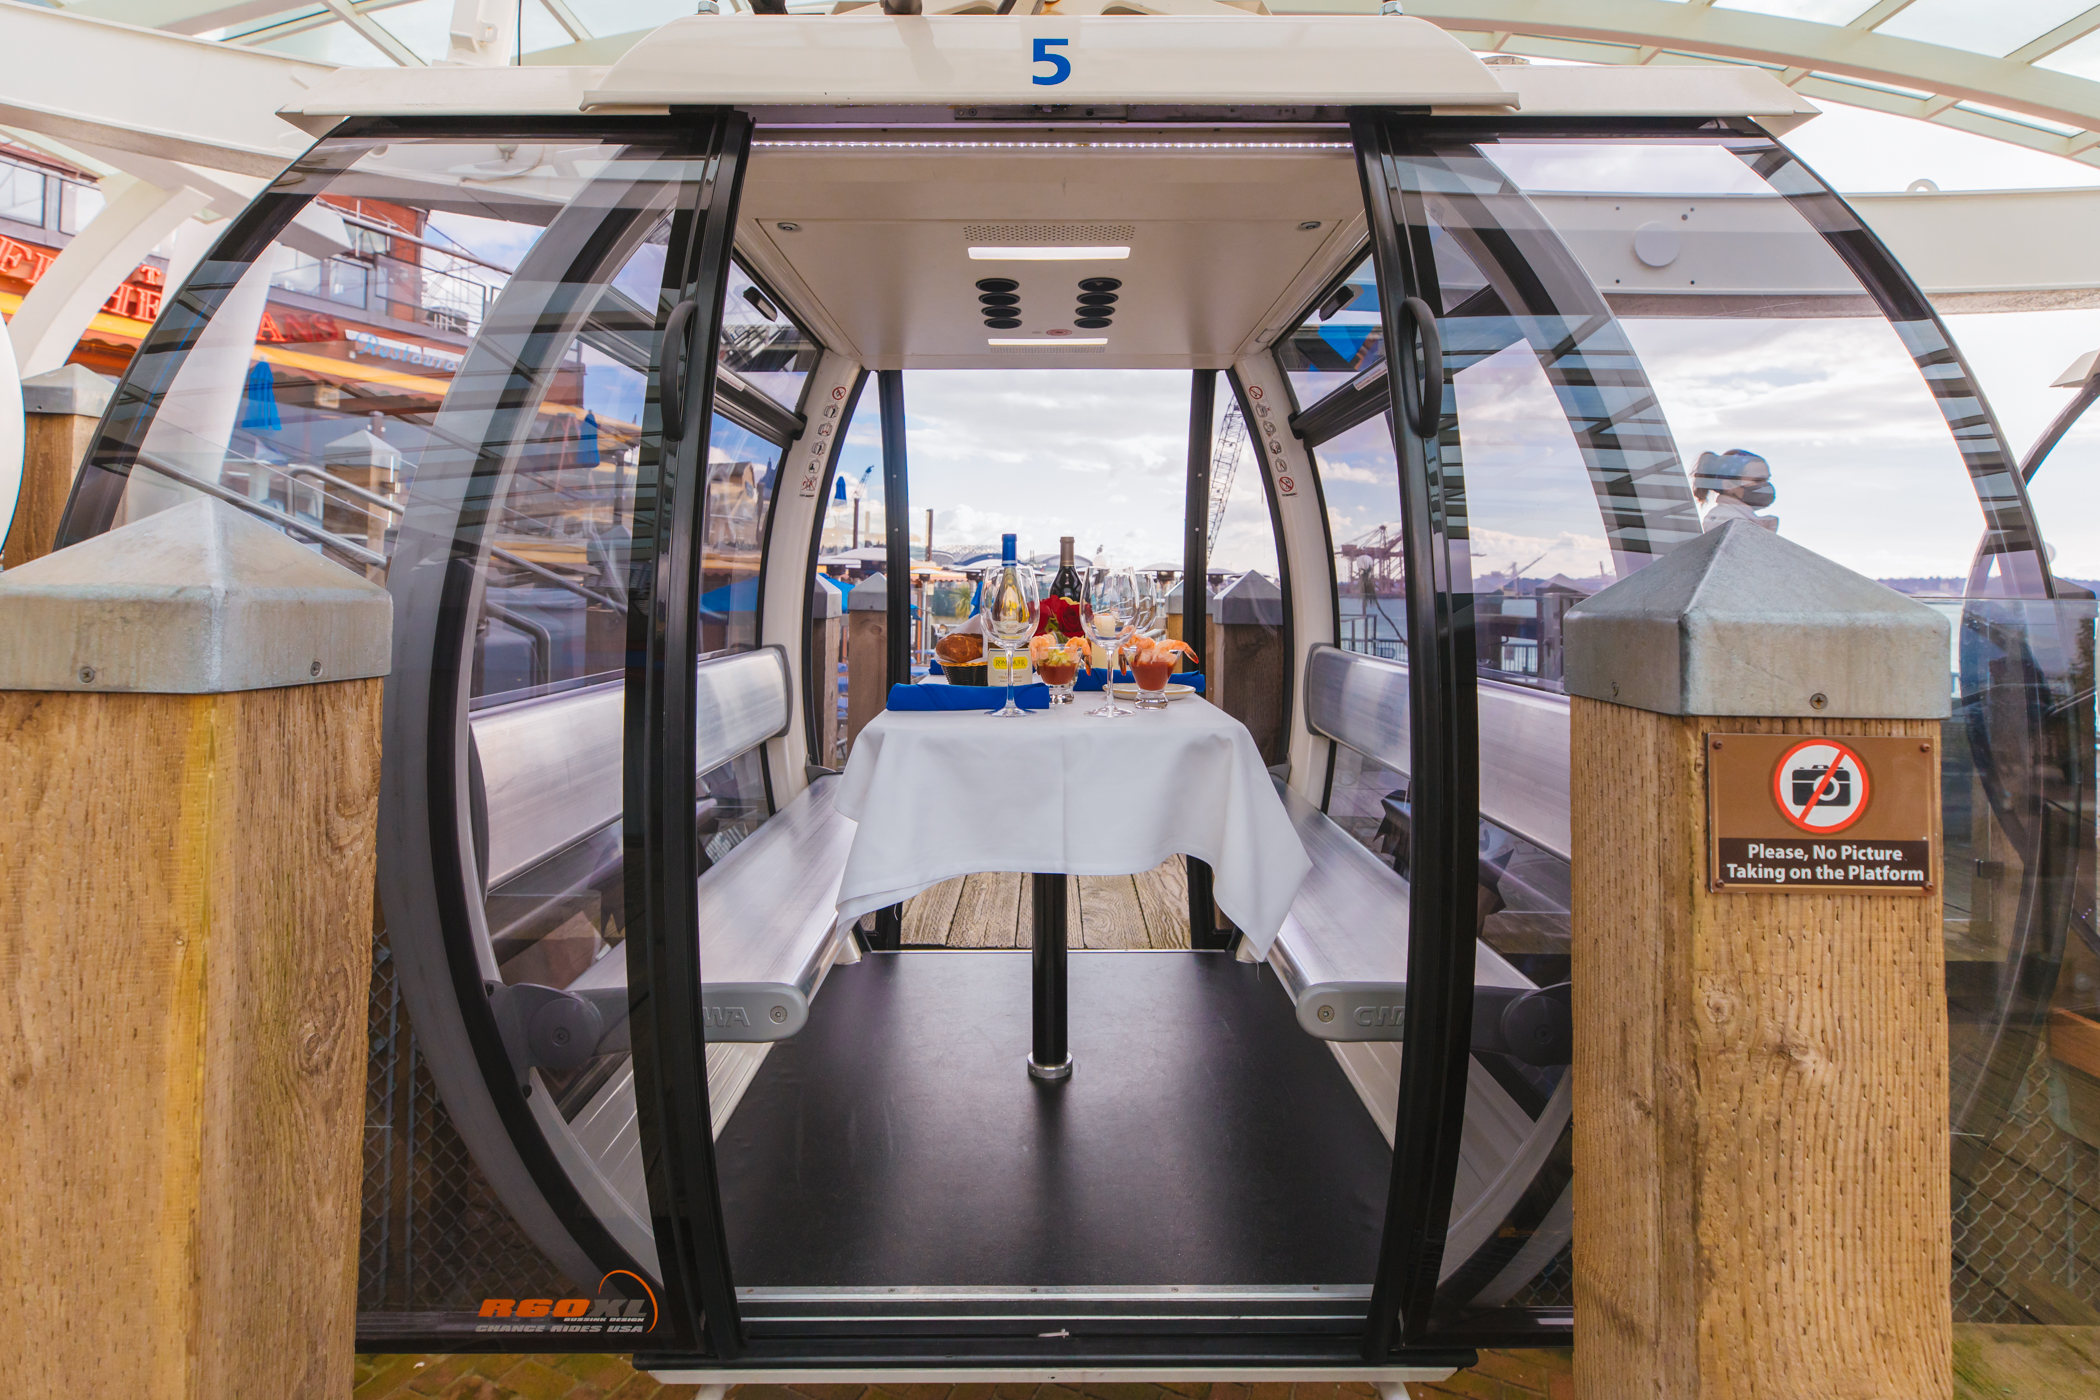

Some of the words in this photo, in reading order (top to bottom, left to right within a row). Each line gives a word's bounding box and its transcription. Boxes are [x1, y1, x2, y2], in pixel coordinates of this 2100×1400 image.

[1032, 37, 1071, 86] 5
[355, 331, 460, 373] Restaura
[1748, 843, 1809, 862] Please,
[1812, 844, 1837, 861] No
[1841, 845, 1903, 862] Picture
[1726, 863, 1786, 883] Taking
[1789, 867, 1812, 880] on
[1815, 865, 1845, 881] the
[1848, 865, 1924, 882] Platform
[703, 1006, 751, 1028] WA
[475, 1324, 546, 1333] CHANCE
[550, 1324, 603, 1333] RIDES
[606, 1324, 644, 1333] USA
